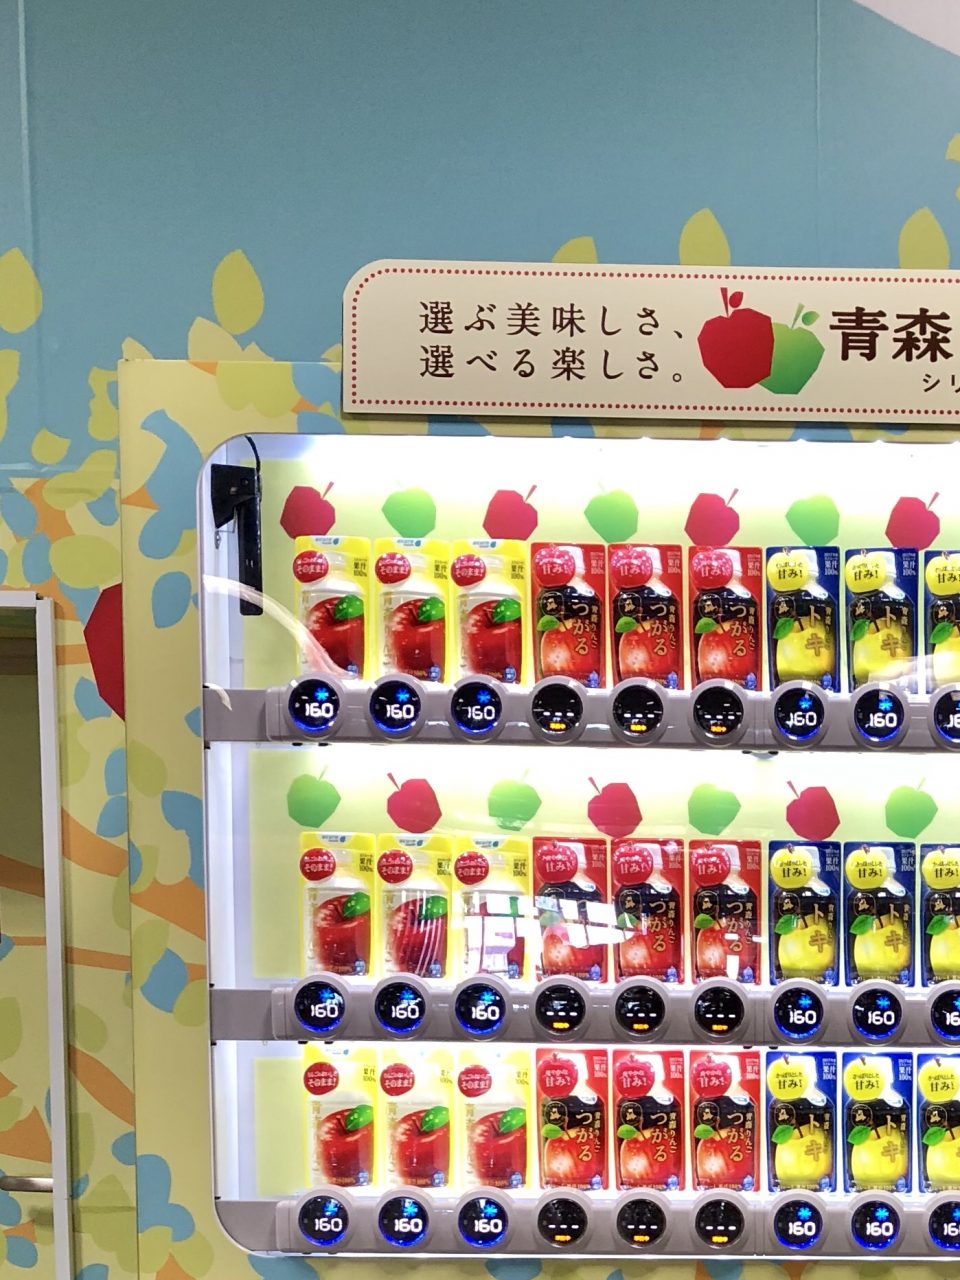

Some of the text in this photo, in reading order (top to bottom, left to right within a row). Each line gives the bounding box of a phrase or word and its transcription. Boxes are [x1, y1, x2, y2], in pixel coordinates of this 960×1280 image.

[419, 301, 682, 339] 選ぶ美味しさ、
[419, 344, 682, 382] 選べる楽しさ。
[572, 603, 590, 654] つがる
[650, 604, 668, 656] つがる
[729, 604, 748, 656] つがる
[806, 605, 824, 656] トキ
[882, 606, 899, 657] トキ
[305, 703, 334, 717] 160
[386, 704, 414, 719] 160
[468, 706, 495, 720] 160
[790, 712, 817, 727] 160
[870, 713, 897, 727] 160
[650, 901, 667, 951] つがる
[809, 904, 827, 953] トキ
[885, 904, 902, 953] トキ
[310, 1004, 339, 1018] 160
[392, 1006, 419, 1019] 160
[472, 1006, 500, 1020] 160
[789, 1011, 817, 1024] 160
[868, 1011, 895, 1025] 160
[576, 1112, 593, 1161] つがる
[651, 1112, 668, 1161] つがる
[727, 1112, 744, 1161] つがる
[805, 1115, 822, 1162] トキ
[882, 1115, 899, 1162] トキ
[315, 1218, 342, 1232] 160
[394, 1219, 422, 1232] 160
[475, 1219, 502, 1233] 160
[789, 1222, 816, 1235] 160
[866, 1222, 893, 1235] 160
